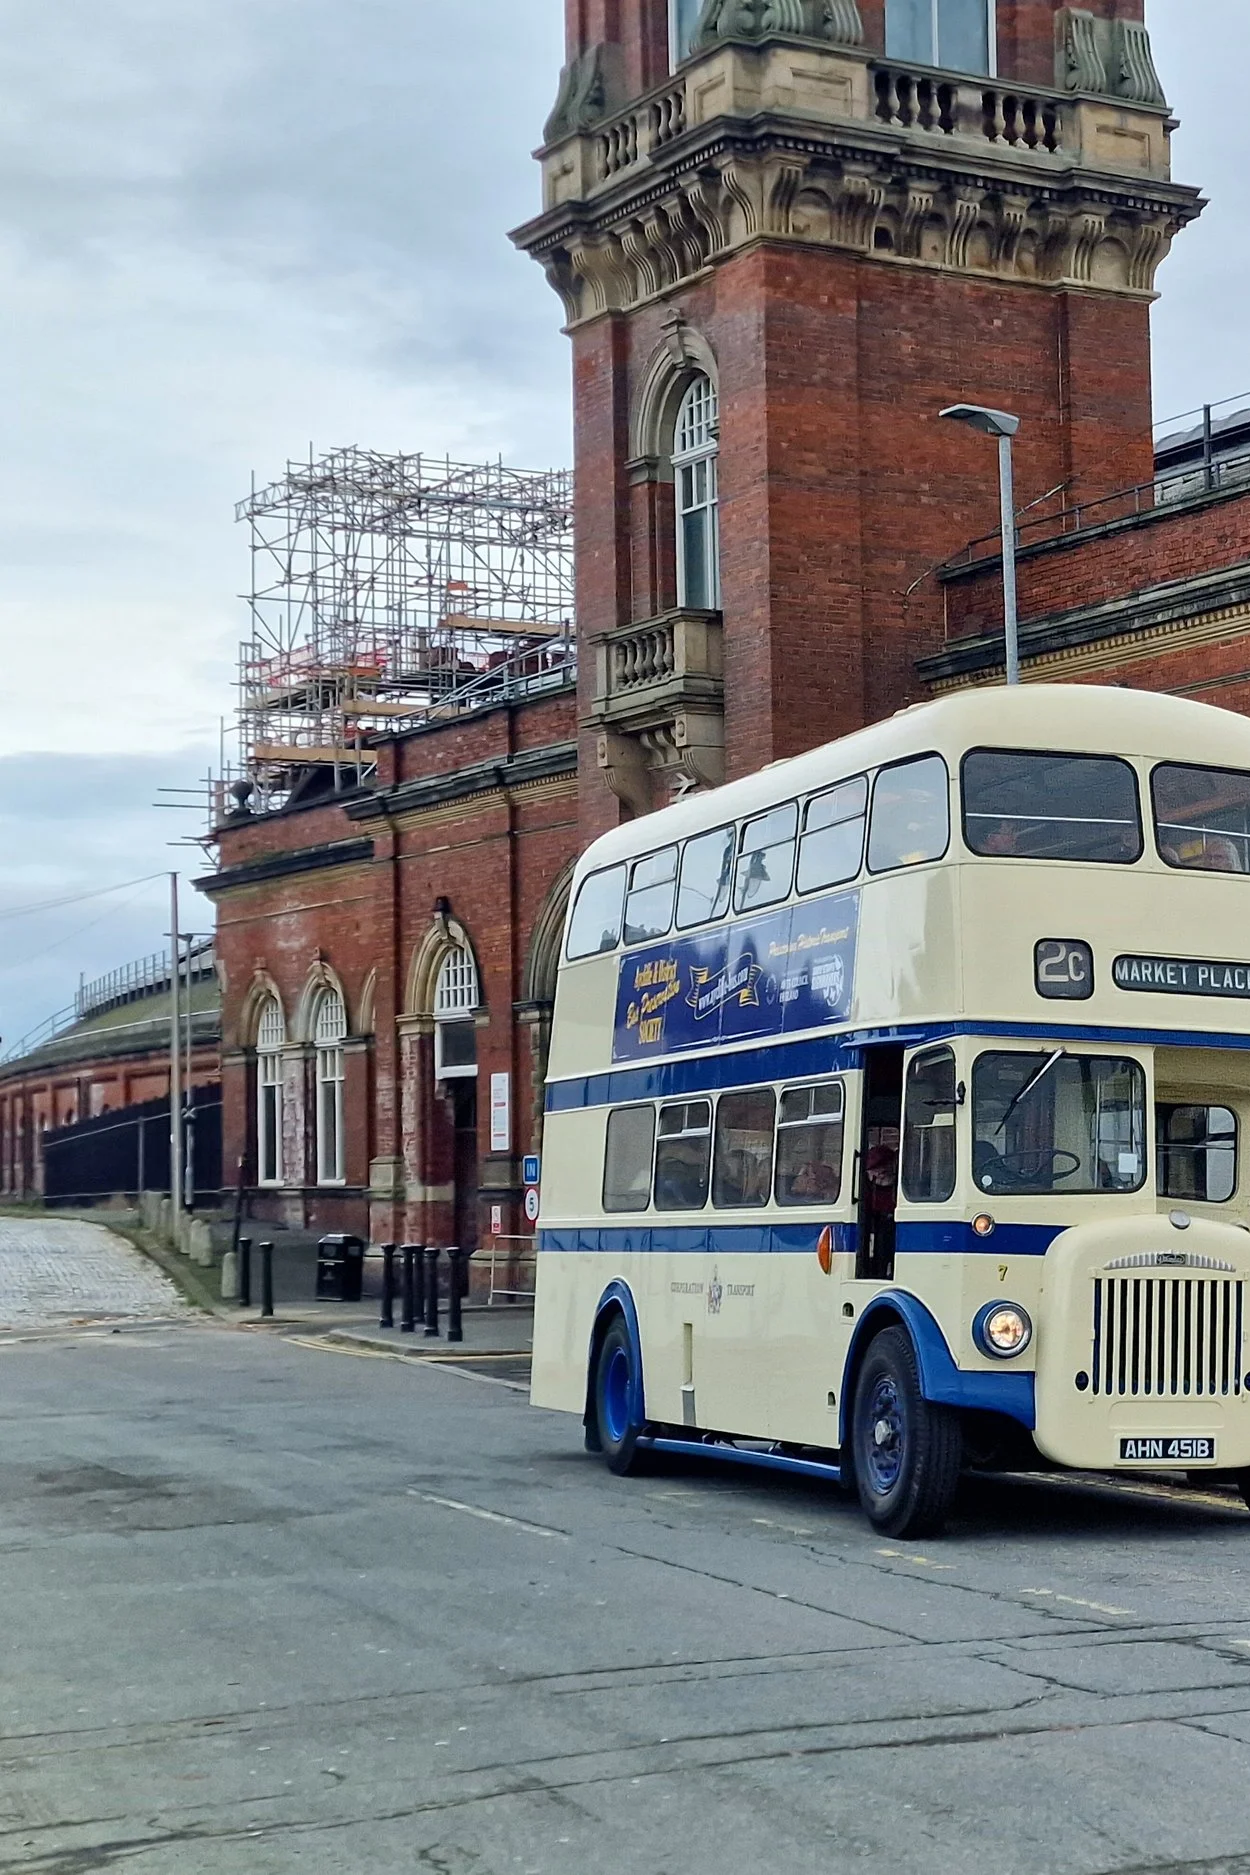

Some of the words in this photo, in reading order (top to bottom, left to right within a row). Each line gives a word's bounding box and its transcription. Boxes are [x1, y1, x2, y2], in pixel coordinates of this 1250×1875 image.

[1038, 941, 1086, 982] 2C
[1115, 959, 1189, 986] MARKET
[527, 1163, 535, 1177] IN
[529, 1197, 535, 1212] 5
[998, 1264, 1008, 1281] 7
[1124, 1439, 1163, 1458] AHN
[1167, 1439, 1209, 1458] 451B
